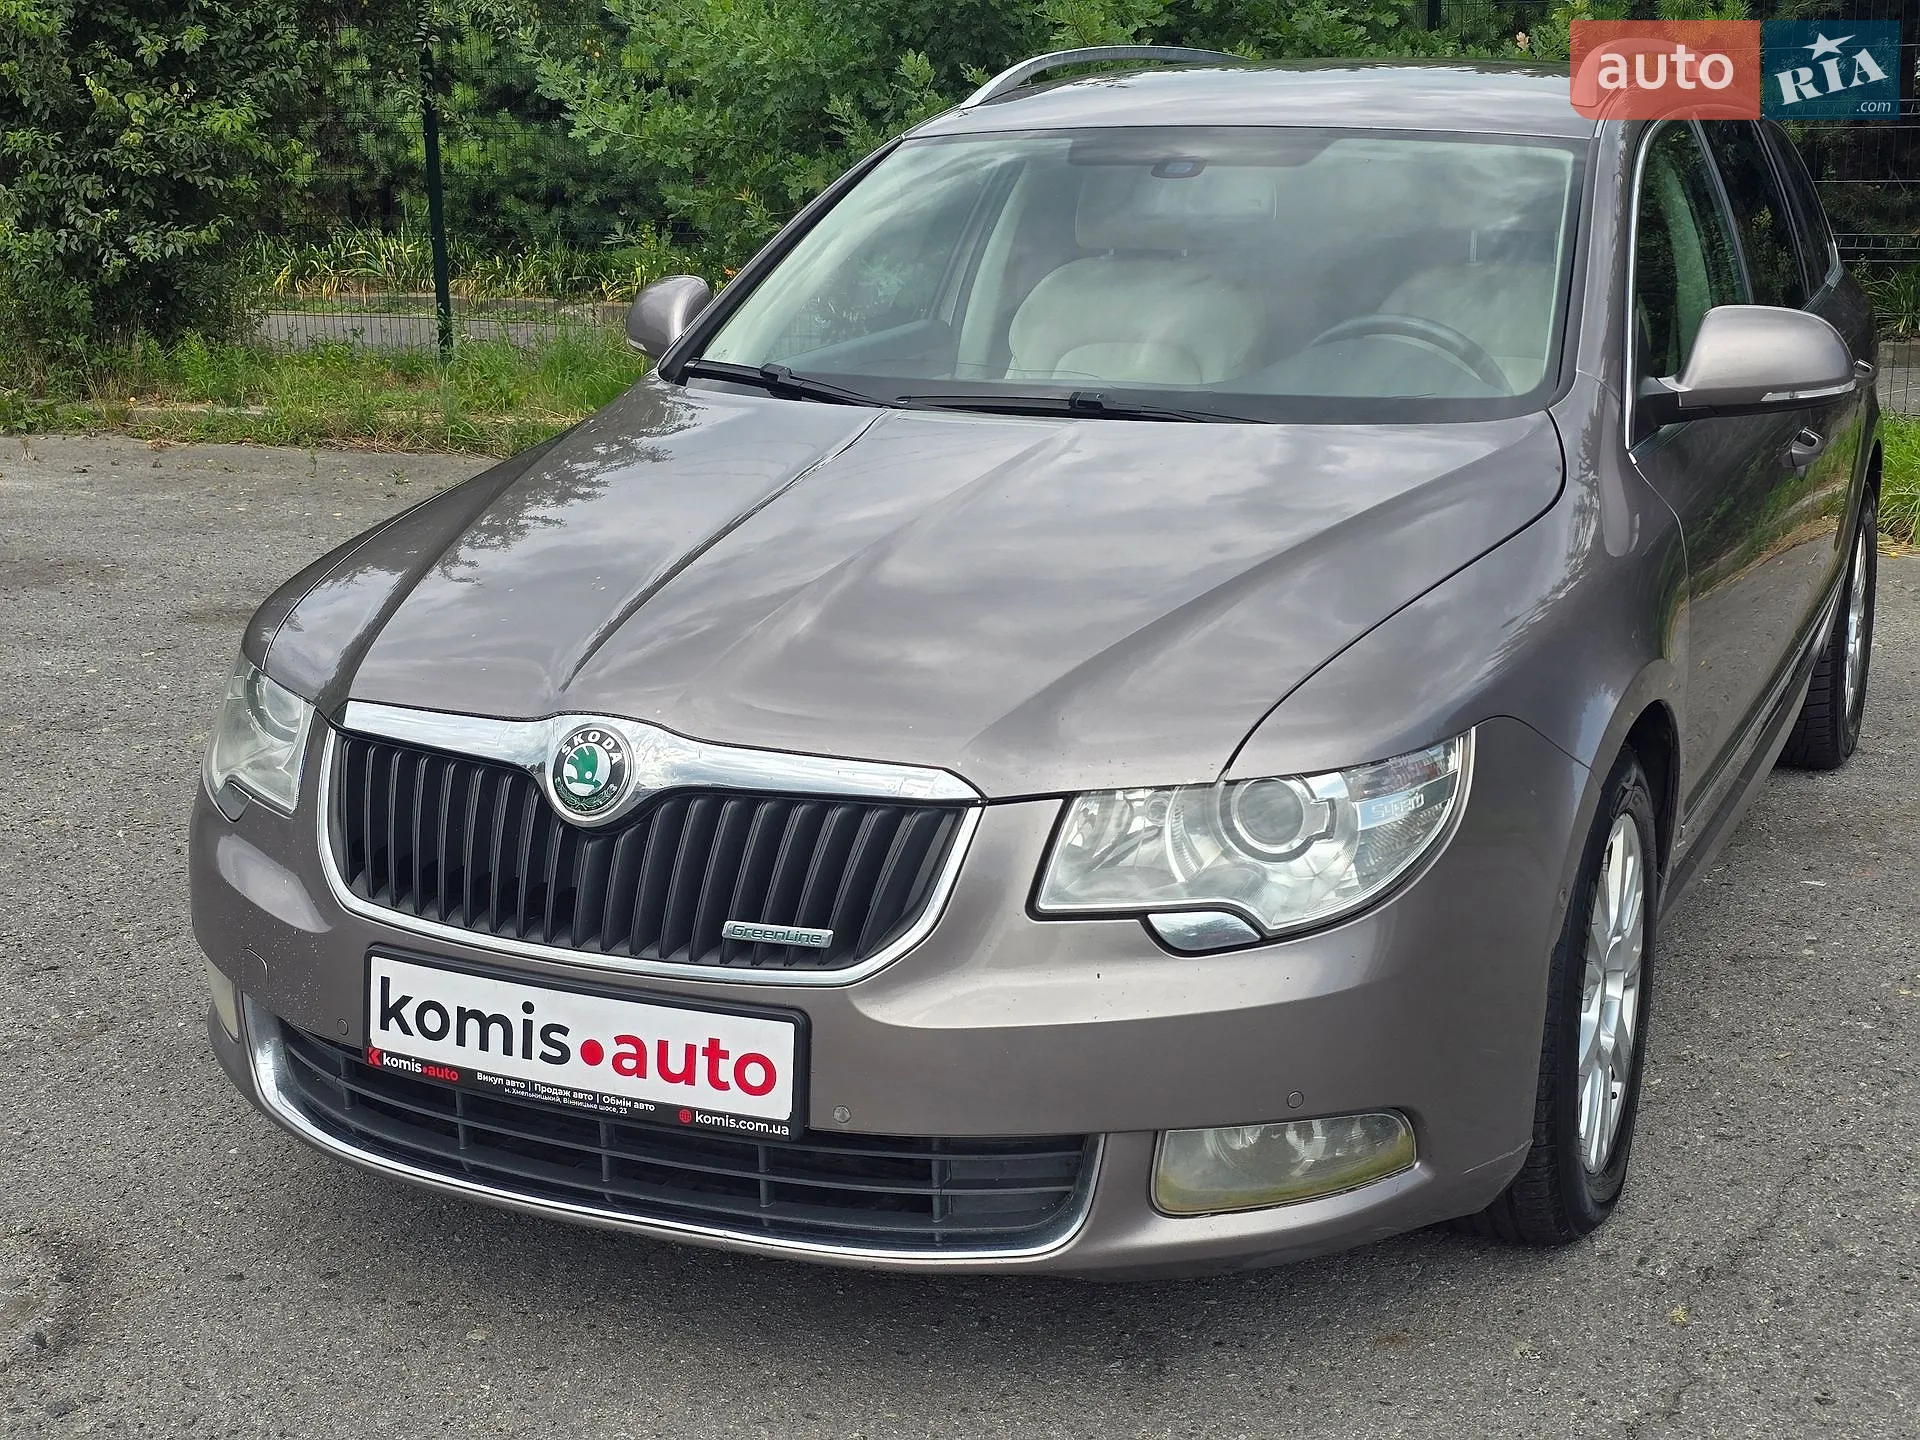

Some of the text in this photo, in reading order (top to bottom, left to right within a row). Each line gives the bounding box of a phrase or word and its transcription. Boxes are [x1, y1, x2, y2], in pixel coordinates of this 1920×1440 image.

[731, 925, 822, 944] GreenLine
[476, 1072, 504, 1085] Викуп
[505, 1079, 526, 1089] авто
[534, 1082, 571, 1097] Продаж
[572, 1091, 594, 1101] авто
[602, 1096, 632, 1108] Обмін
[633, 1102, 656, 1111] авто
[619, 1107, 628, 1115] 23
[695, 1111, 790, 1136] komis.com.ua
